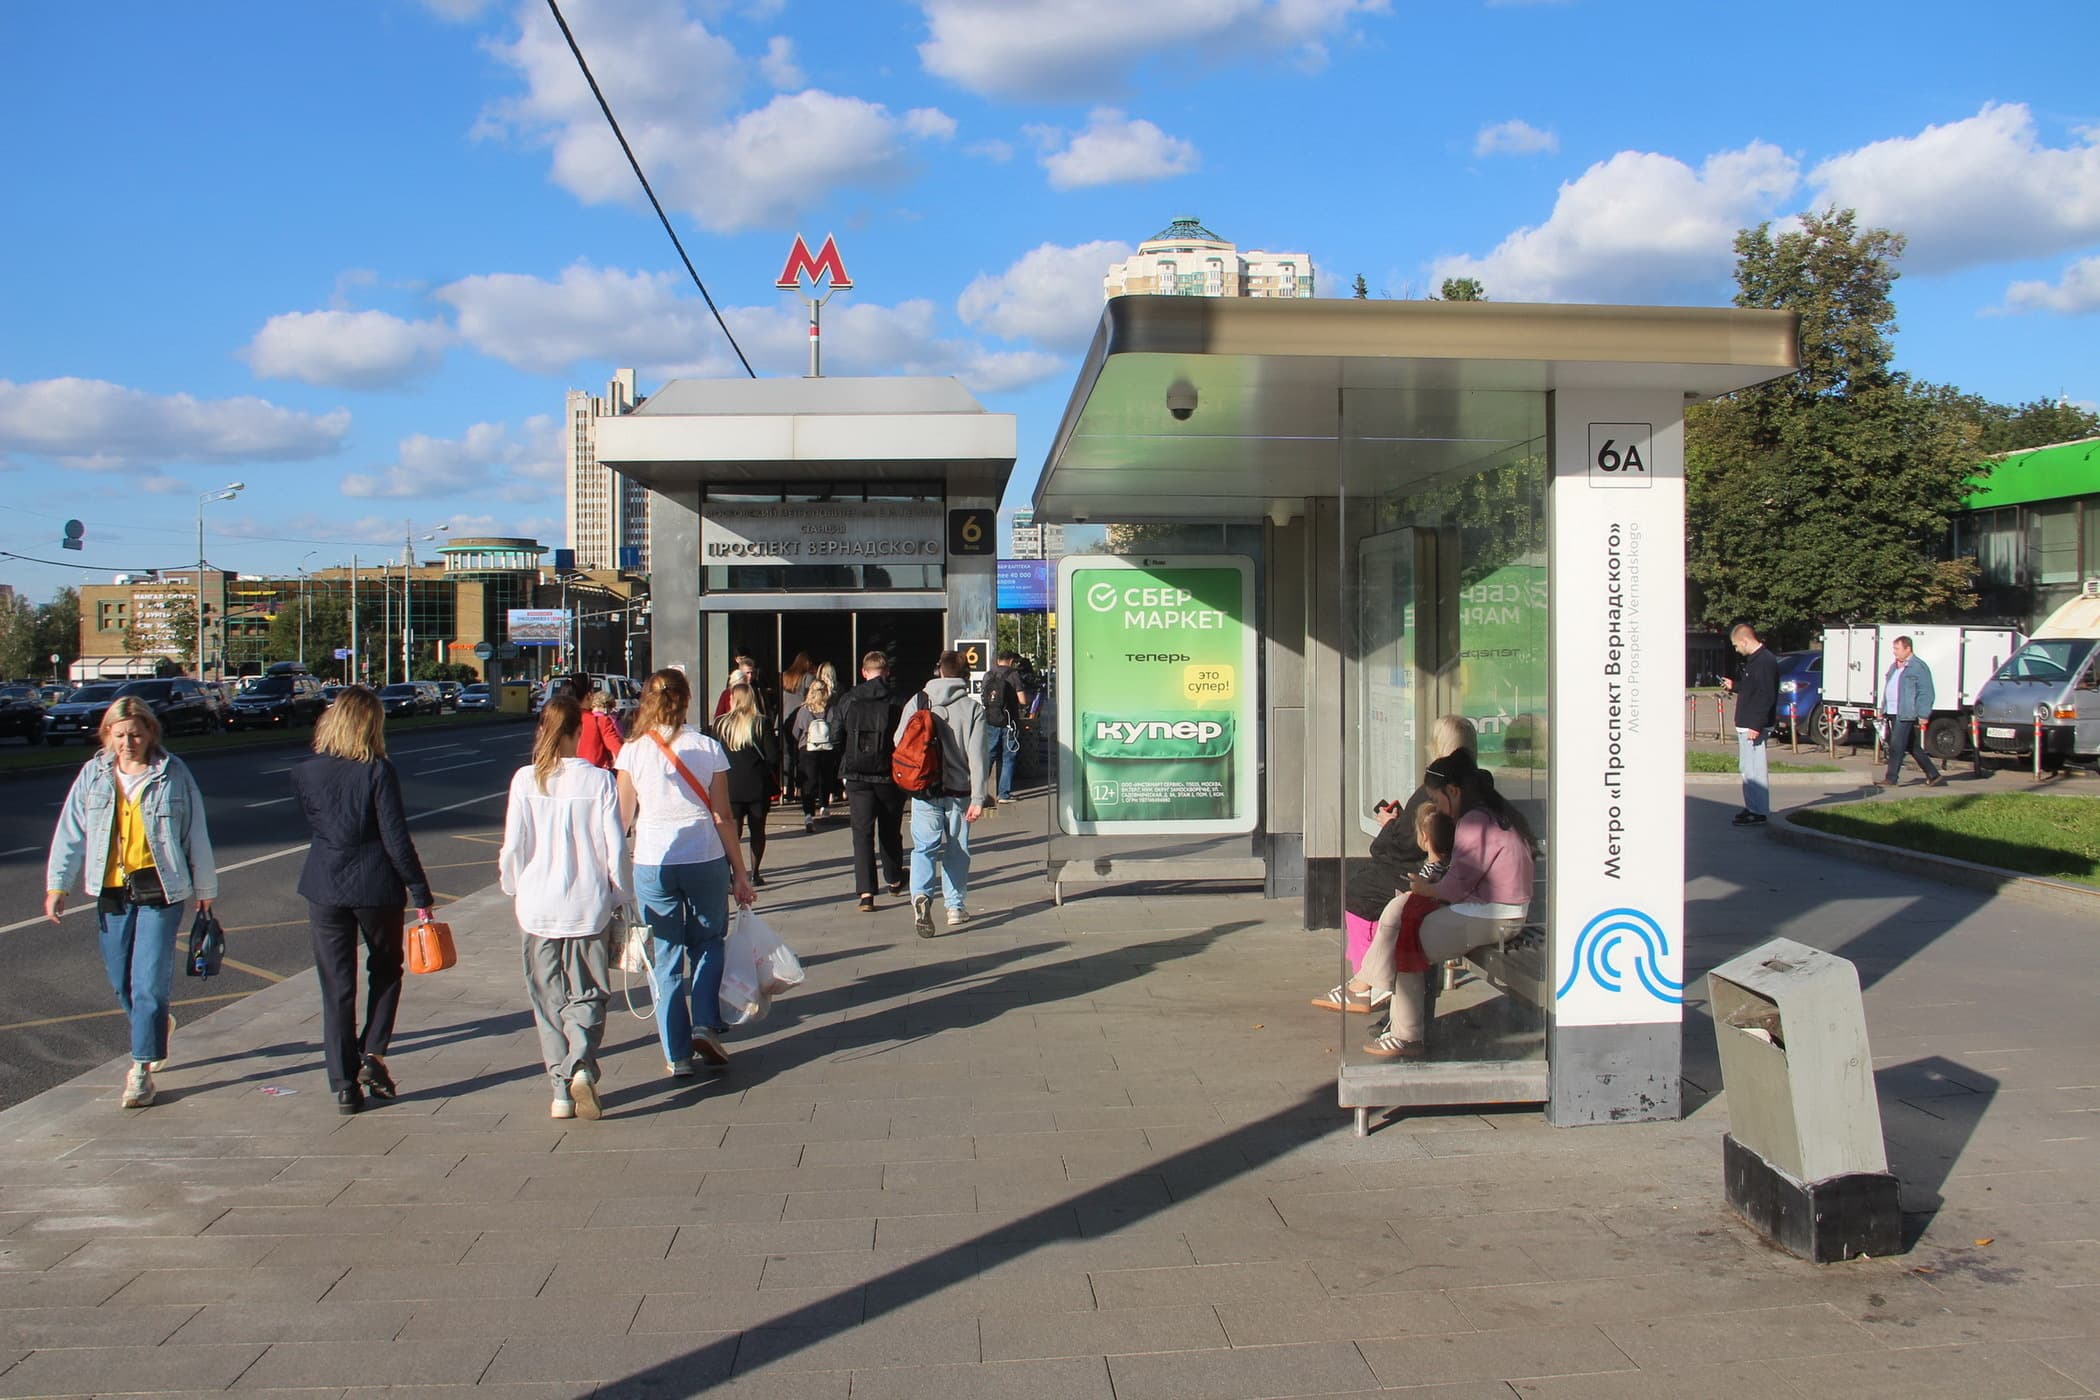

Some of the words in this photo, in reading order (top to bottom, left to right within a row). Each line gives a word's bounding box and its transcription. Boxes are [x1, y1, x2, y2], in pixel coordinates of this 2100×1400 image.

[776, 232, 853, 288] М
[1598, 439, 1645, 472] 6А
[801, 525, 846, 535] СТАНЦИЯ
[961, 515, 982, 543] 6
[708, 541, 801, 557] ПРОСПЕКТ
[807, 541, 938, 557] ВЕРНАДСКОГО
[1627, 522, 1642, 616] Vernadskogo
[1124, 588, 1192, 607] СБЕР
[1604, 522, 1624, 676] Вернадского»
[1124, 611, 1228, 629] МАРКЕТ
[966, 646, 979, 664] 6
[1125, 653, 1191, 664] теперь
[1627, 617, 1642, 685] Prospekt
[1188, 681, 1229, 692] супер!
[1198, 671, 1220, 680] это
[1627, 687, 1640, 733] Metro
[1095, 720, 1223, 744] купер
[1604, 681, 1625, 799] «Проспект
[1093, 784, 1116, 801] 12+
[1604, 805, 1624, 880] Метро
